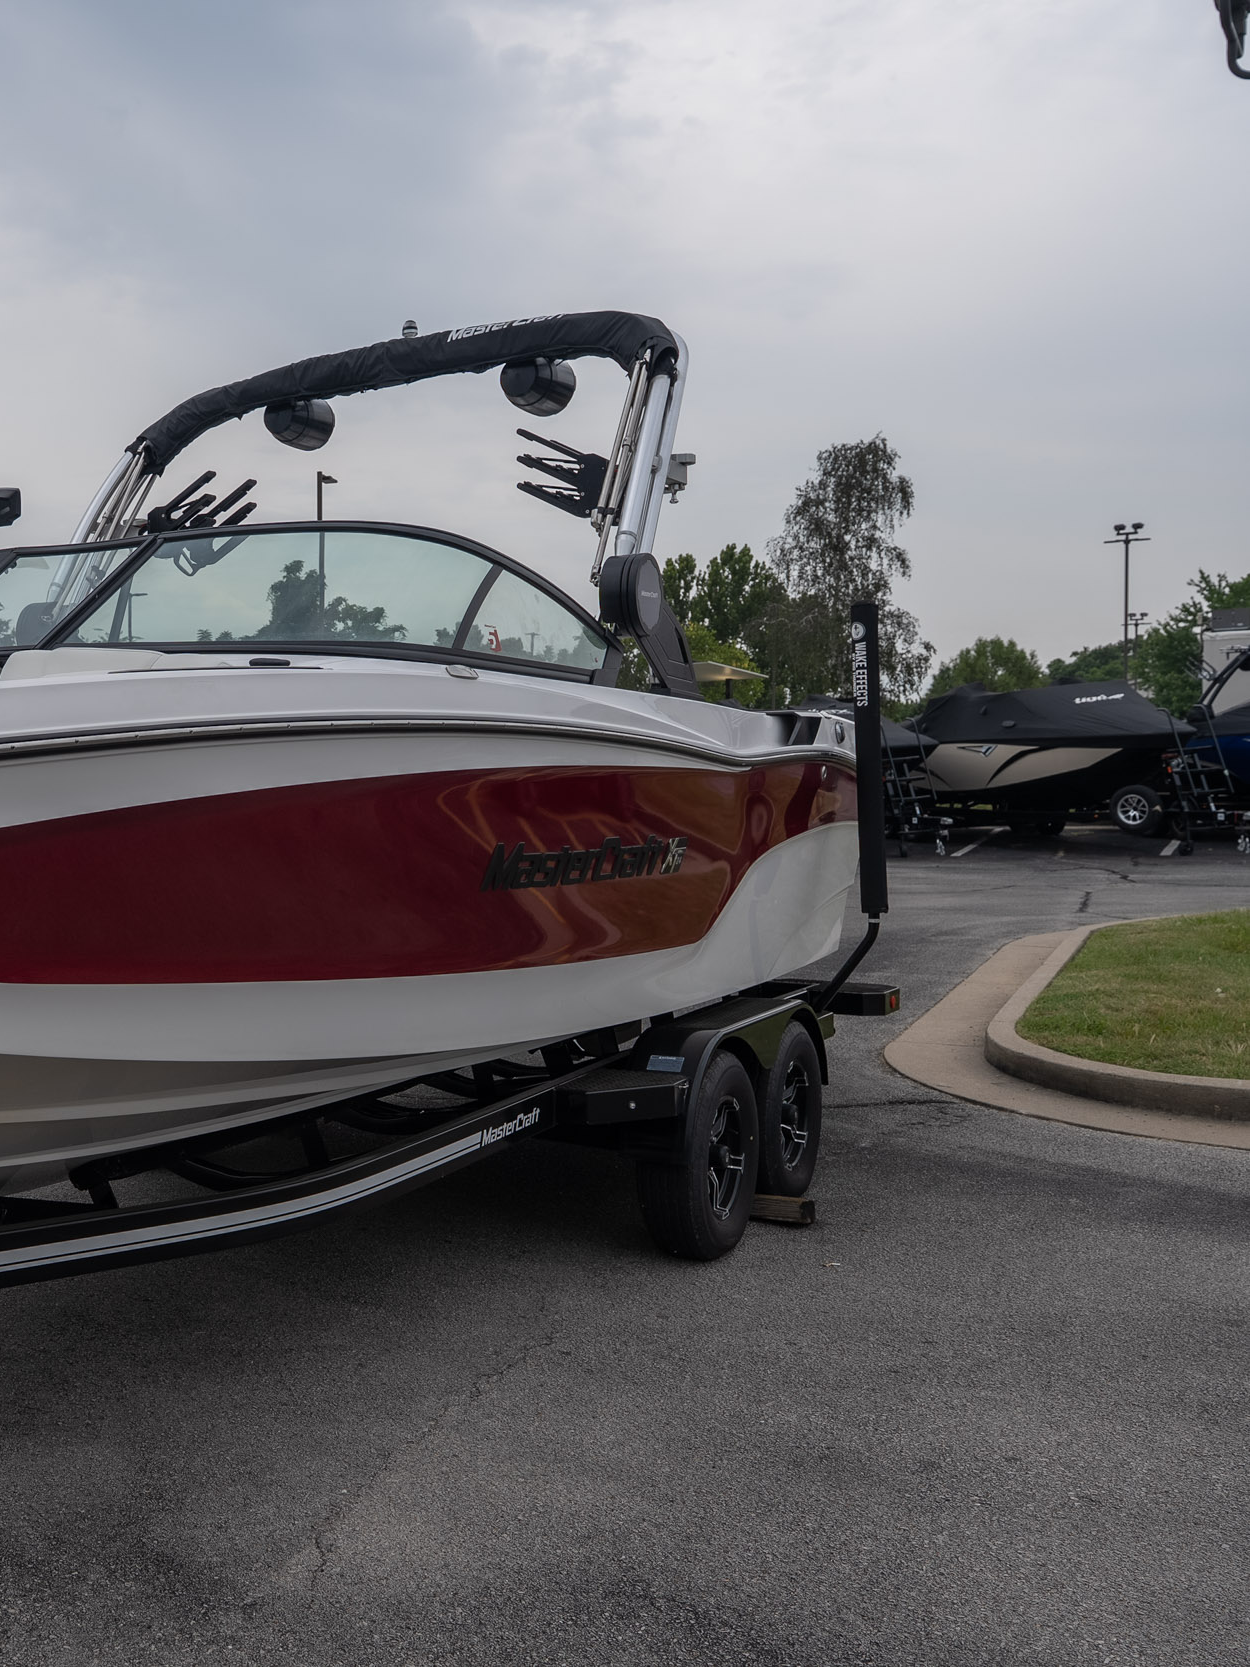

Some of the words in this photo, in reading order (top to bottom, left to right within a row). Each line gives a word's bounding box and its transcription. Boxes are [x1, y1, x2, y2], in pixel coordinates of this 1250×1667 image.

[855, 641, 867, 668] WAKE
[856, 669, 868, 707] EFFECTS
[480, 834, 663, 892] MasterCraft
[481, 1107, 540, 1147] MasterCraft
